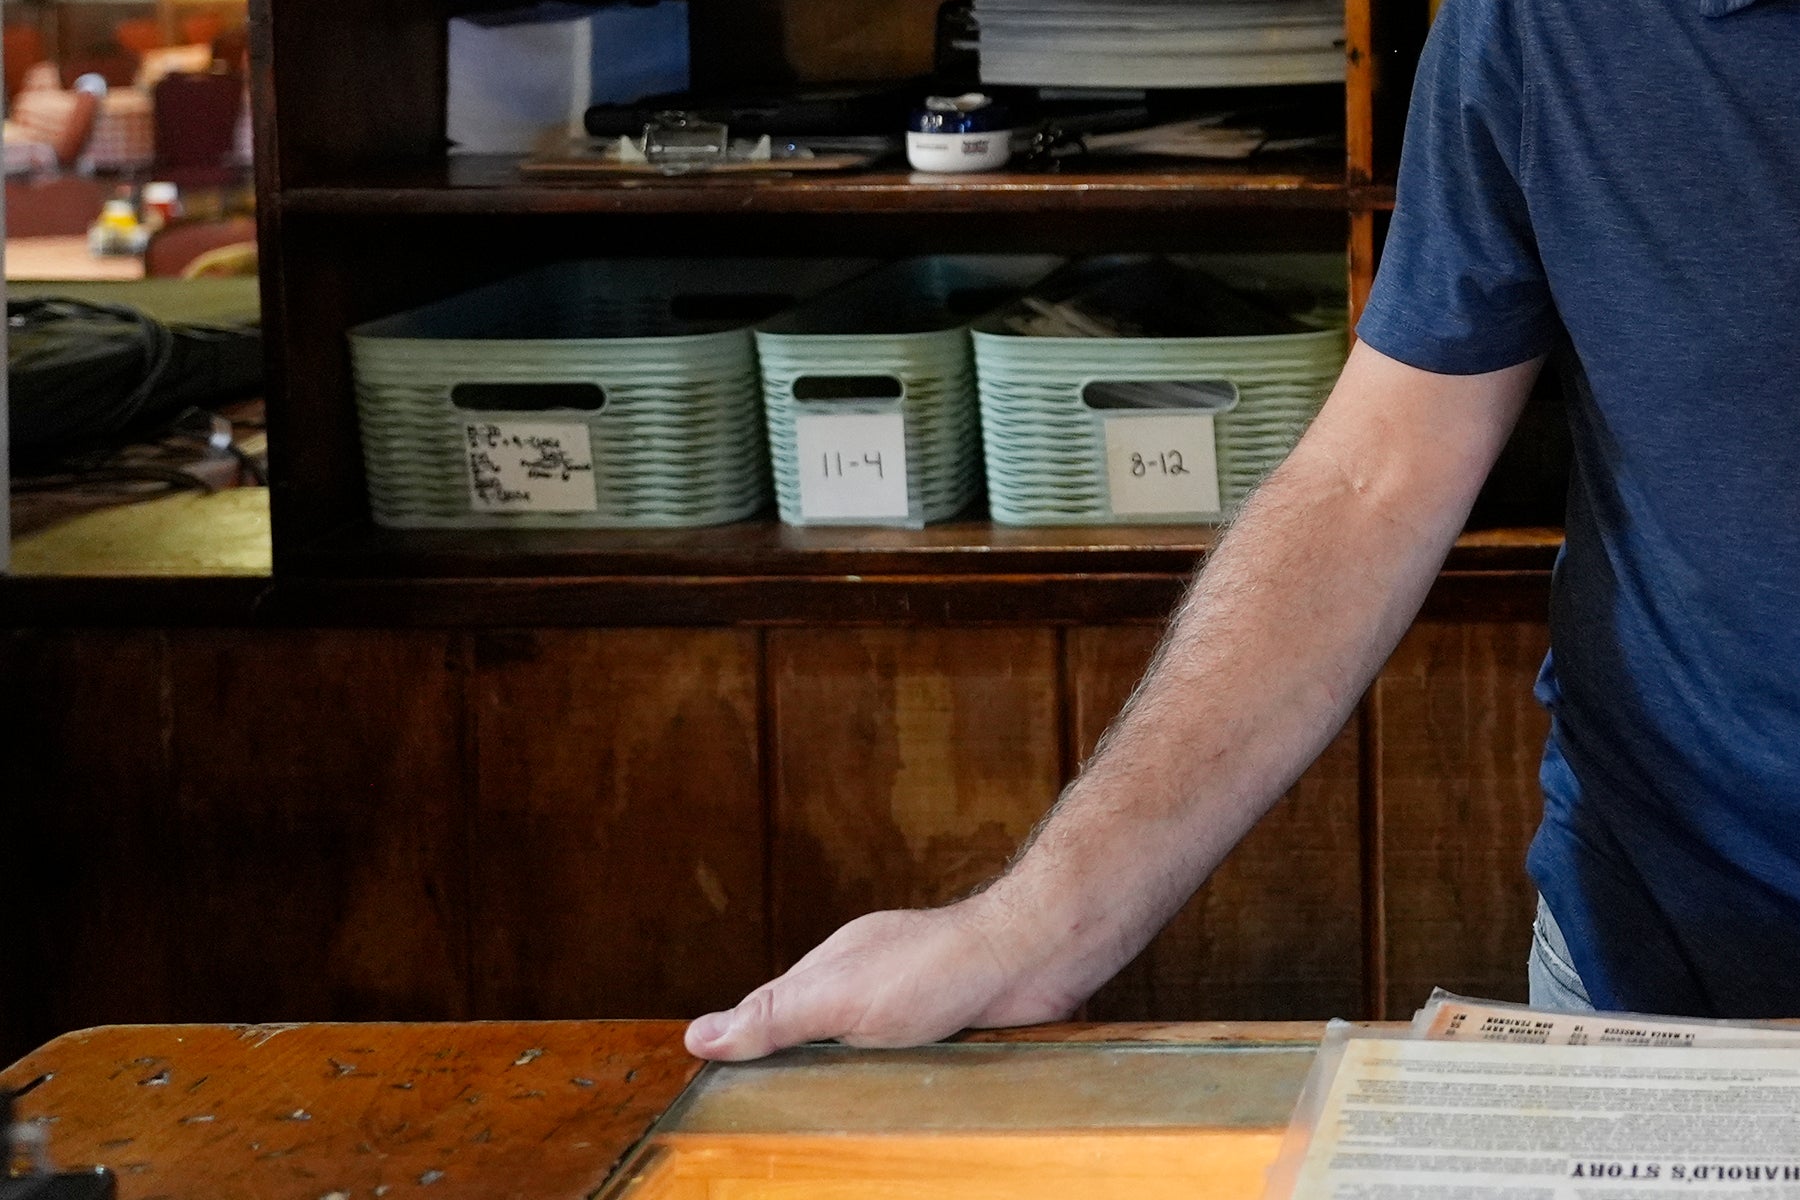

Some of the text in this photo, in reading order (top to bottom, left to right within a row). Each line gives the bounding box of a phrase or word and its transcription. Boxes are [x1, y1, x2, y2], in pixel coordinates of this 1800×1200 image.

[821, 450, 884, 480] 11-4
[1129, 448, 1191, 477] 8-12
[1571, 1162, 1661, 1180] STORY
